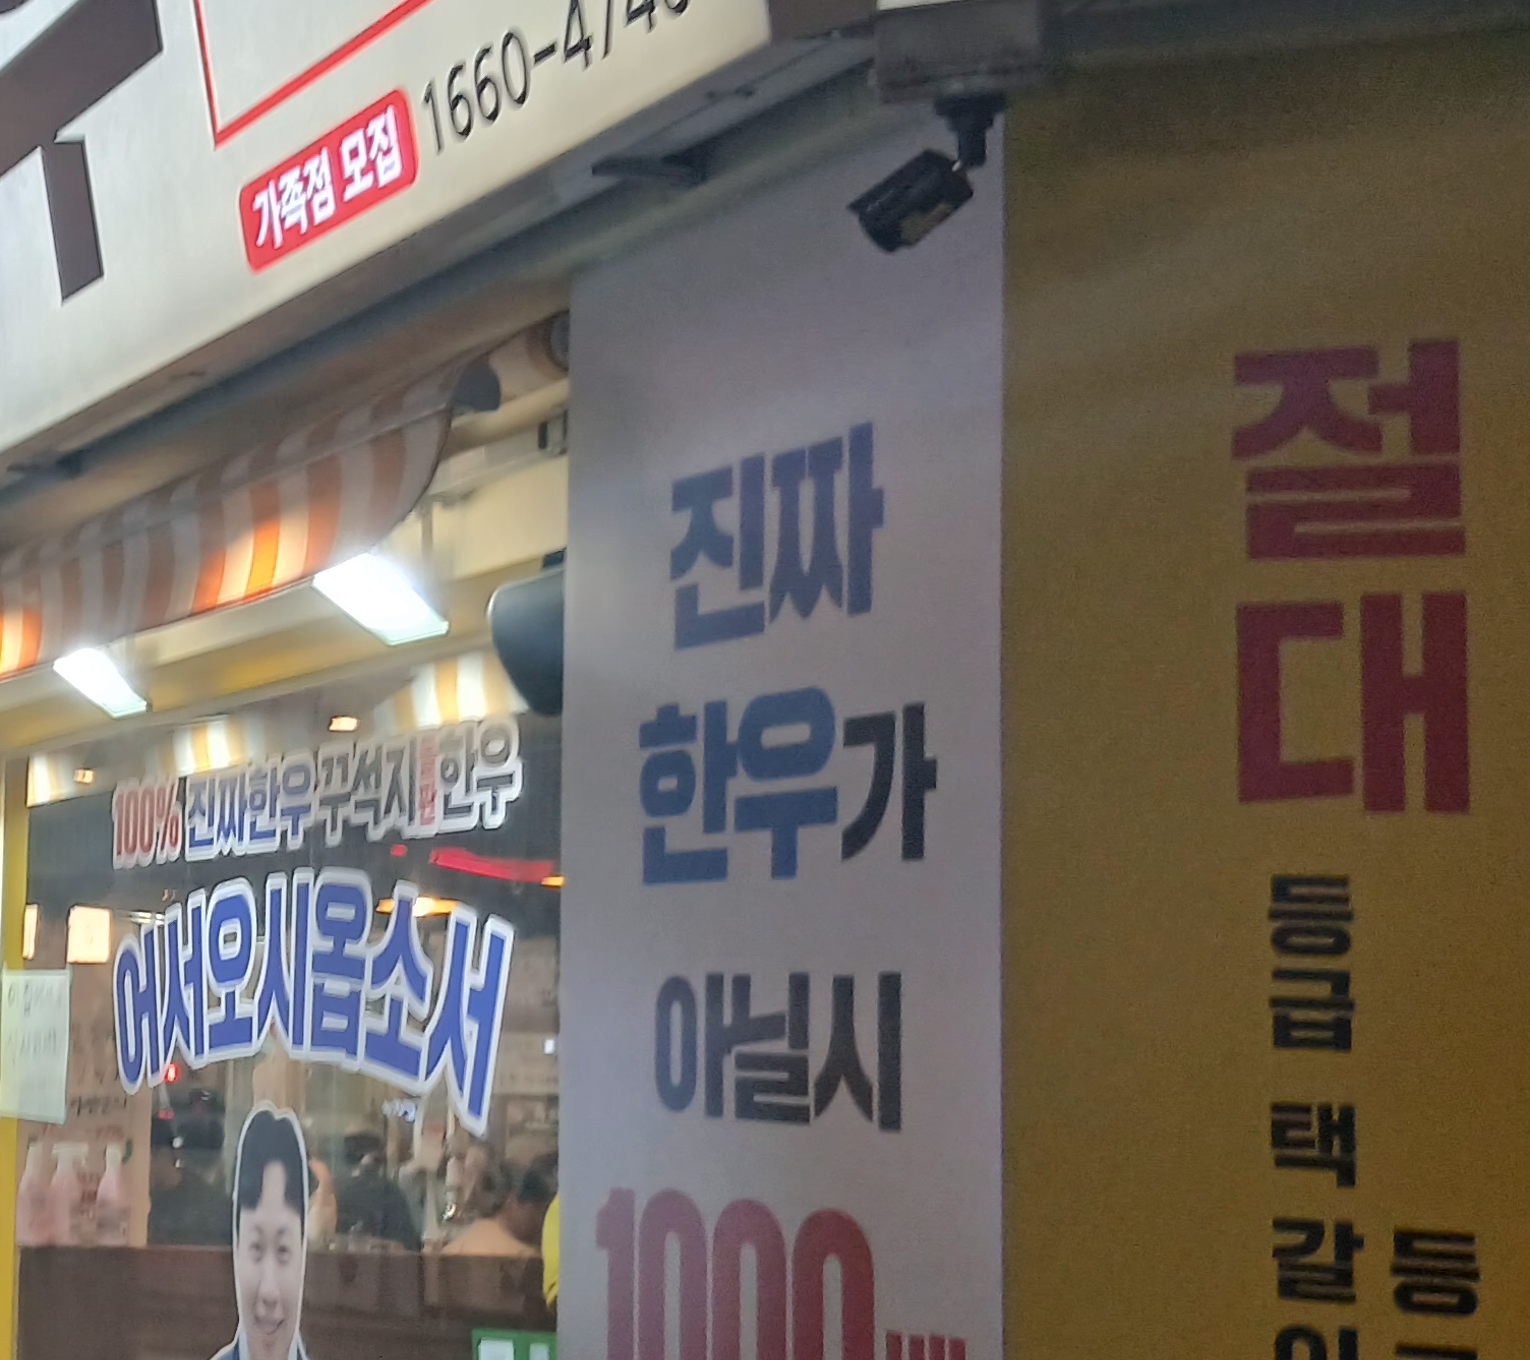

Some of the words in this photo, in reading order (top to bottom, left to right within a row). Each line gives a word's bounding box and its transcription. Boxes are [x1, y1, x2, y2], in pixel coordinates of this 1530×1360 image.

[252, 145, 336, 249] 가족점
[341, 104, 404, 202] 모집
[668, 422, 884, 651] 진짜
[1232, 337, 1469, 814] 절대
[114, 777, 181, 863] 100%
[438, 722, 520, 822] 한우
[638, 685, 938, 887] 한우가
[115, 871, 512, 1125] 어서오시옵소서
[653, 970, 902, 1132] 아닐시
[1267, 873, 1355, 1052] 등급
